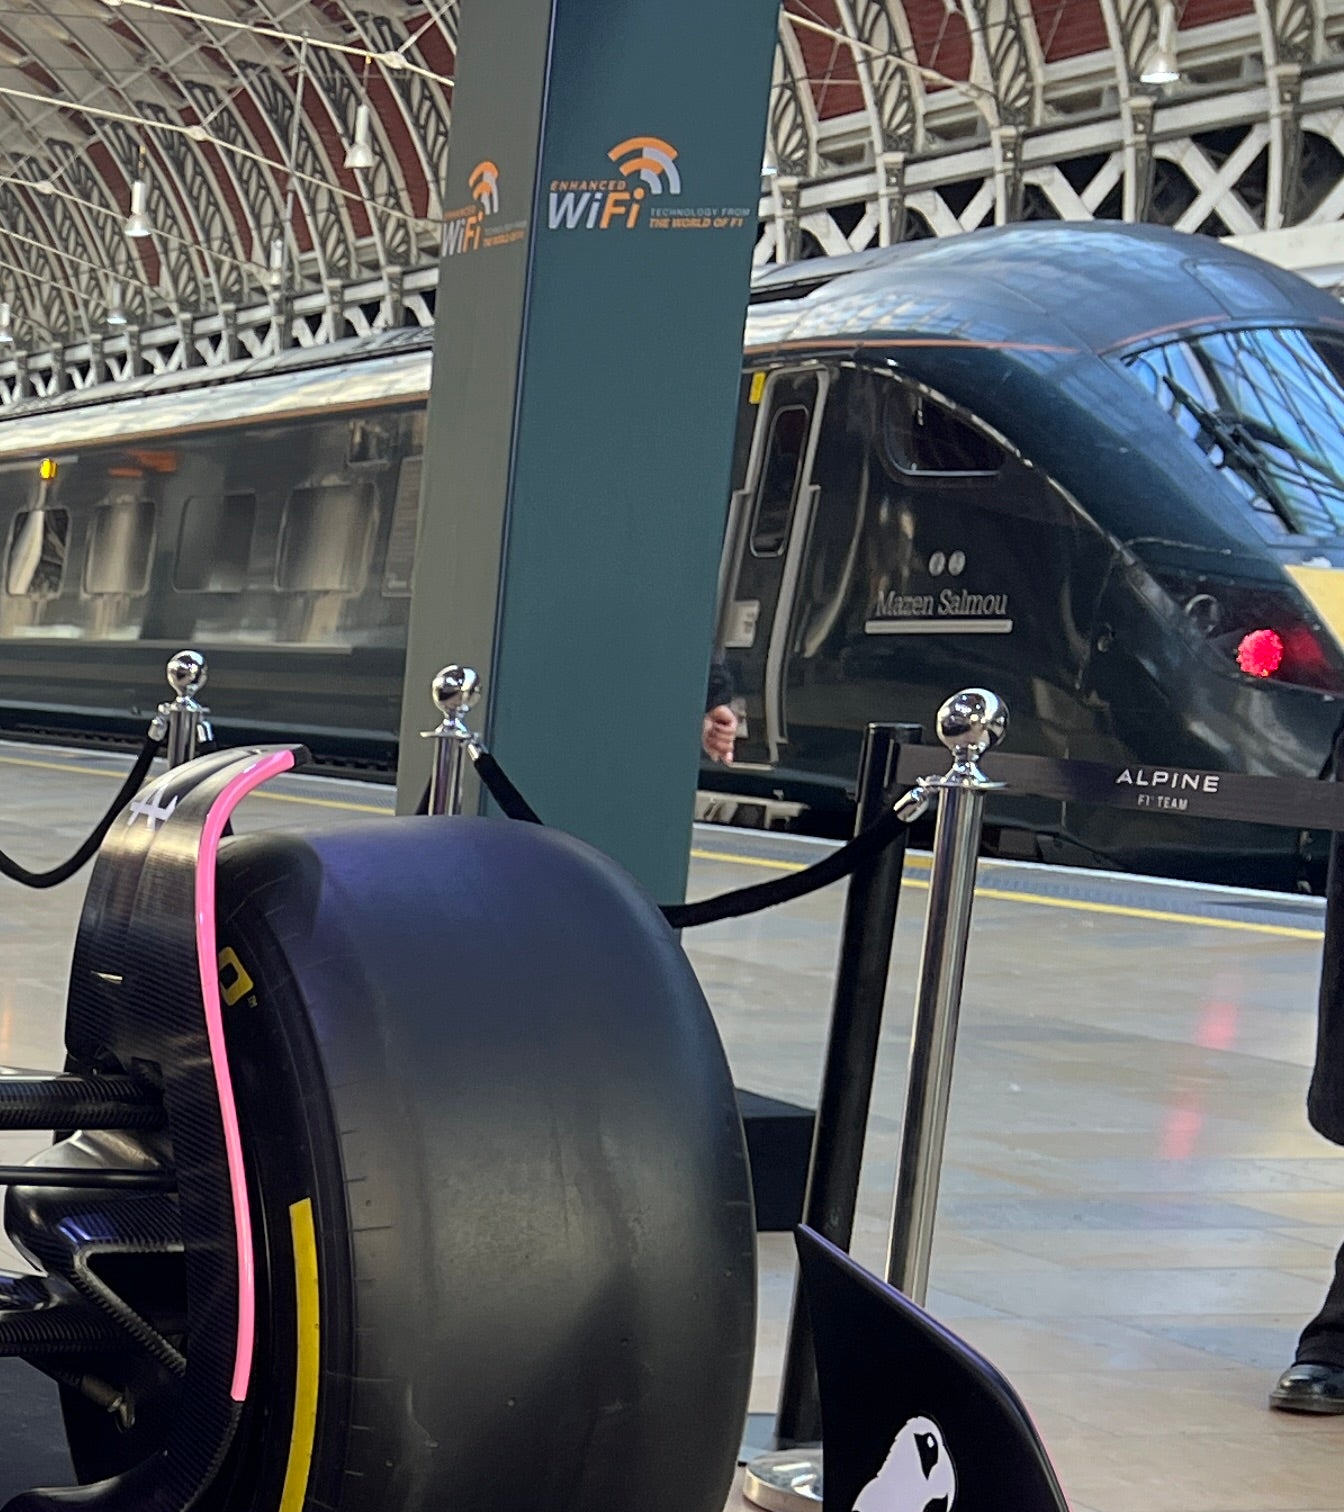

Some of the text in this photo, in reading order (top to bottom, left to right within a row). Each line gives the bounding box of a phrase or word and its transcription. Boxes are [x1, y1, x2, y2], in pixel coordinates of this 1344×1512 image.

[550, 180, 627, 191] ENHANCED
[548, 187, 645, 229] WiFi
[650, 207, 751, 217] TECHNOLOGY FROM
[442, 210, 484, 257] WiFi
[875, 588, 1009, 617] Mazen Salmou
[1115, 768, 1220, 793] ALPINE
[1157, 795, 1189, 811] TEAM
